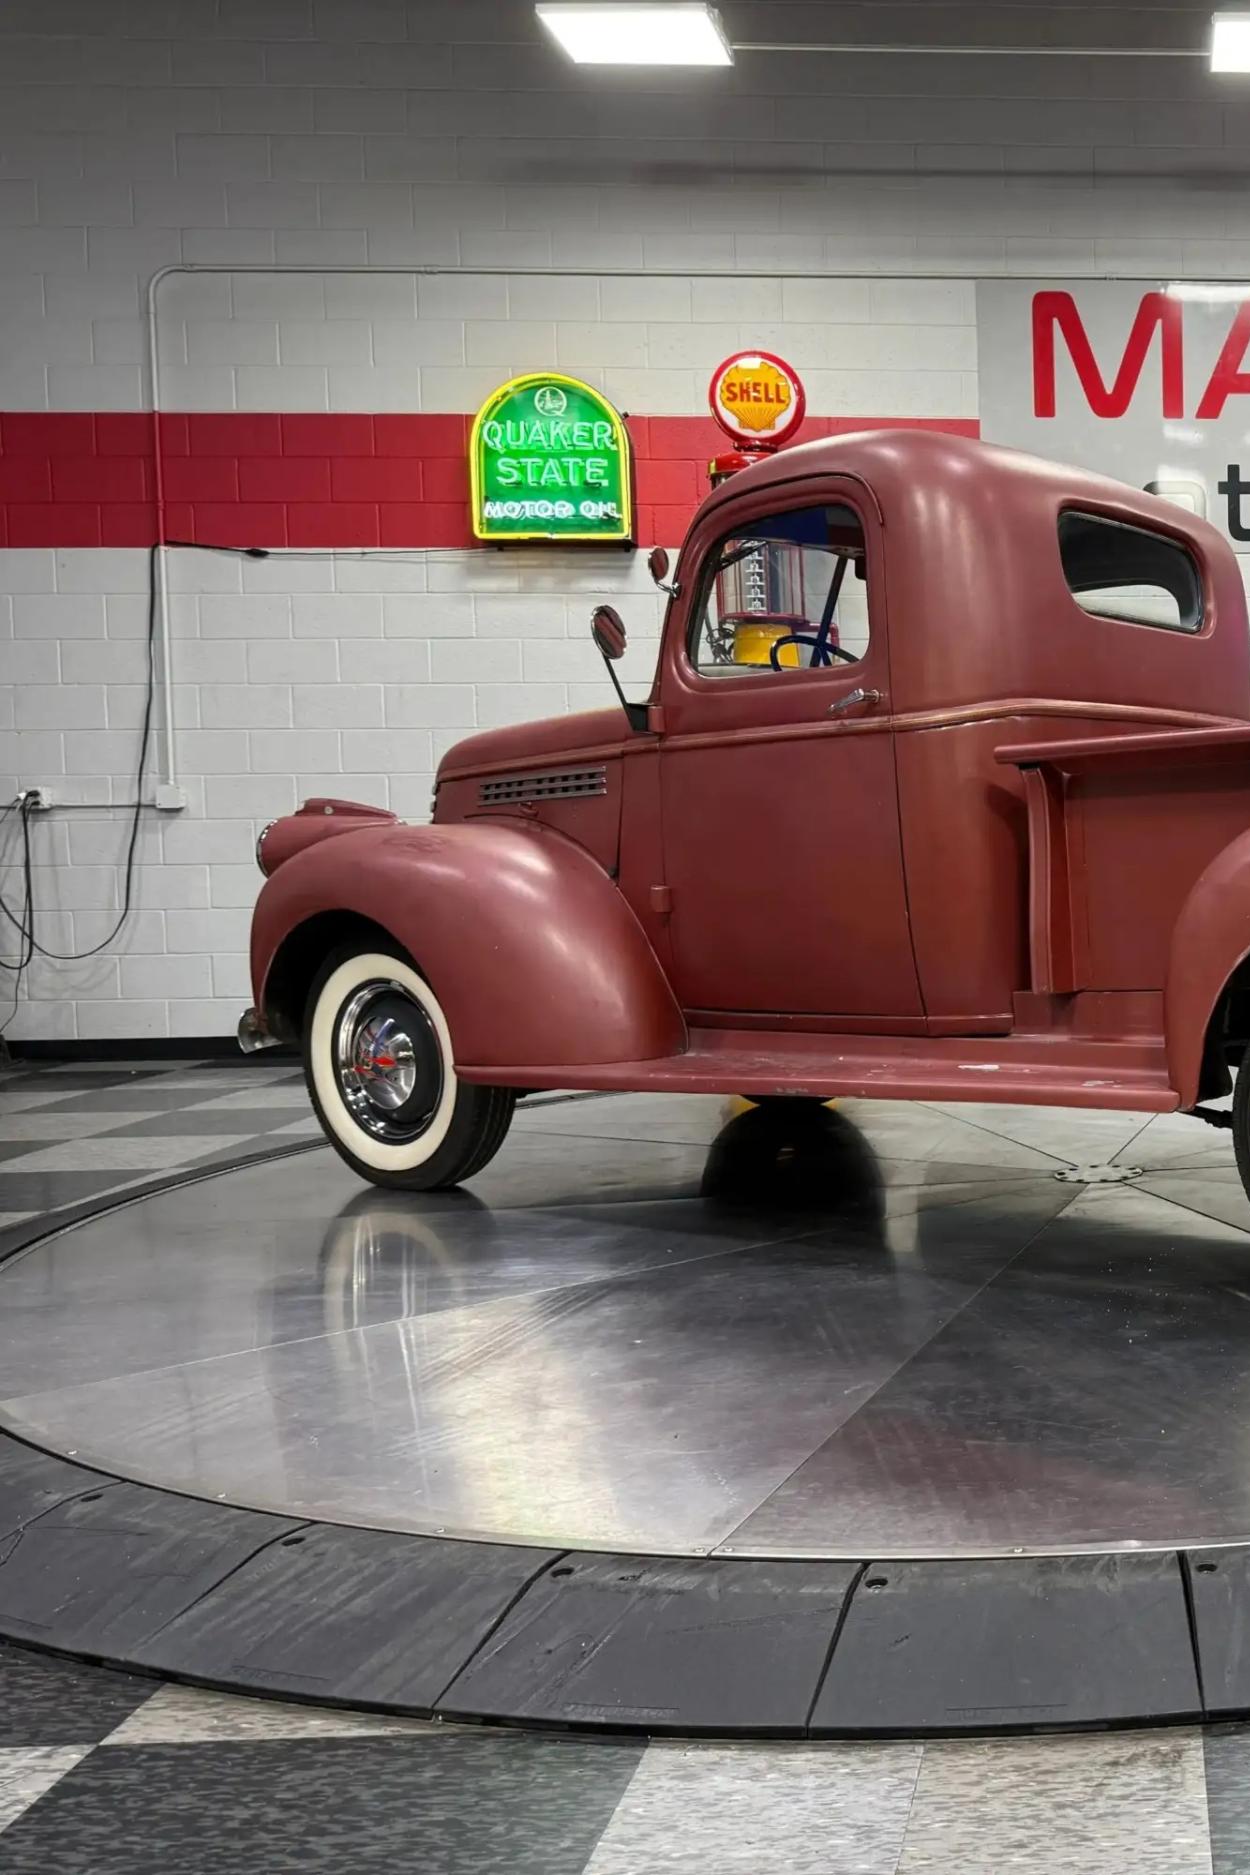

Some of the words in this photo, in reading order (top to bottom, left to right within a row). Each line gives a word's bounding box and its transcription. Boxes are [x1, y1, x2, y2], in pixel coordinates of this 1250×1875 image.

[726, 382, 786, 404] SHELL
[482, 420, 617, 454] QUAKER
[496, 457, 609, 487] STATE
[484, 500, 575, 519] MOTOR
[580, 500, 622, 519] OIL
